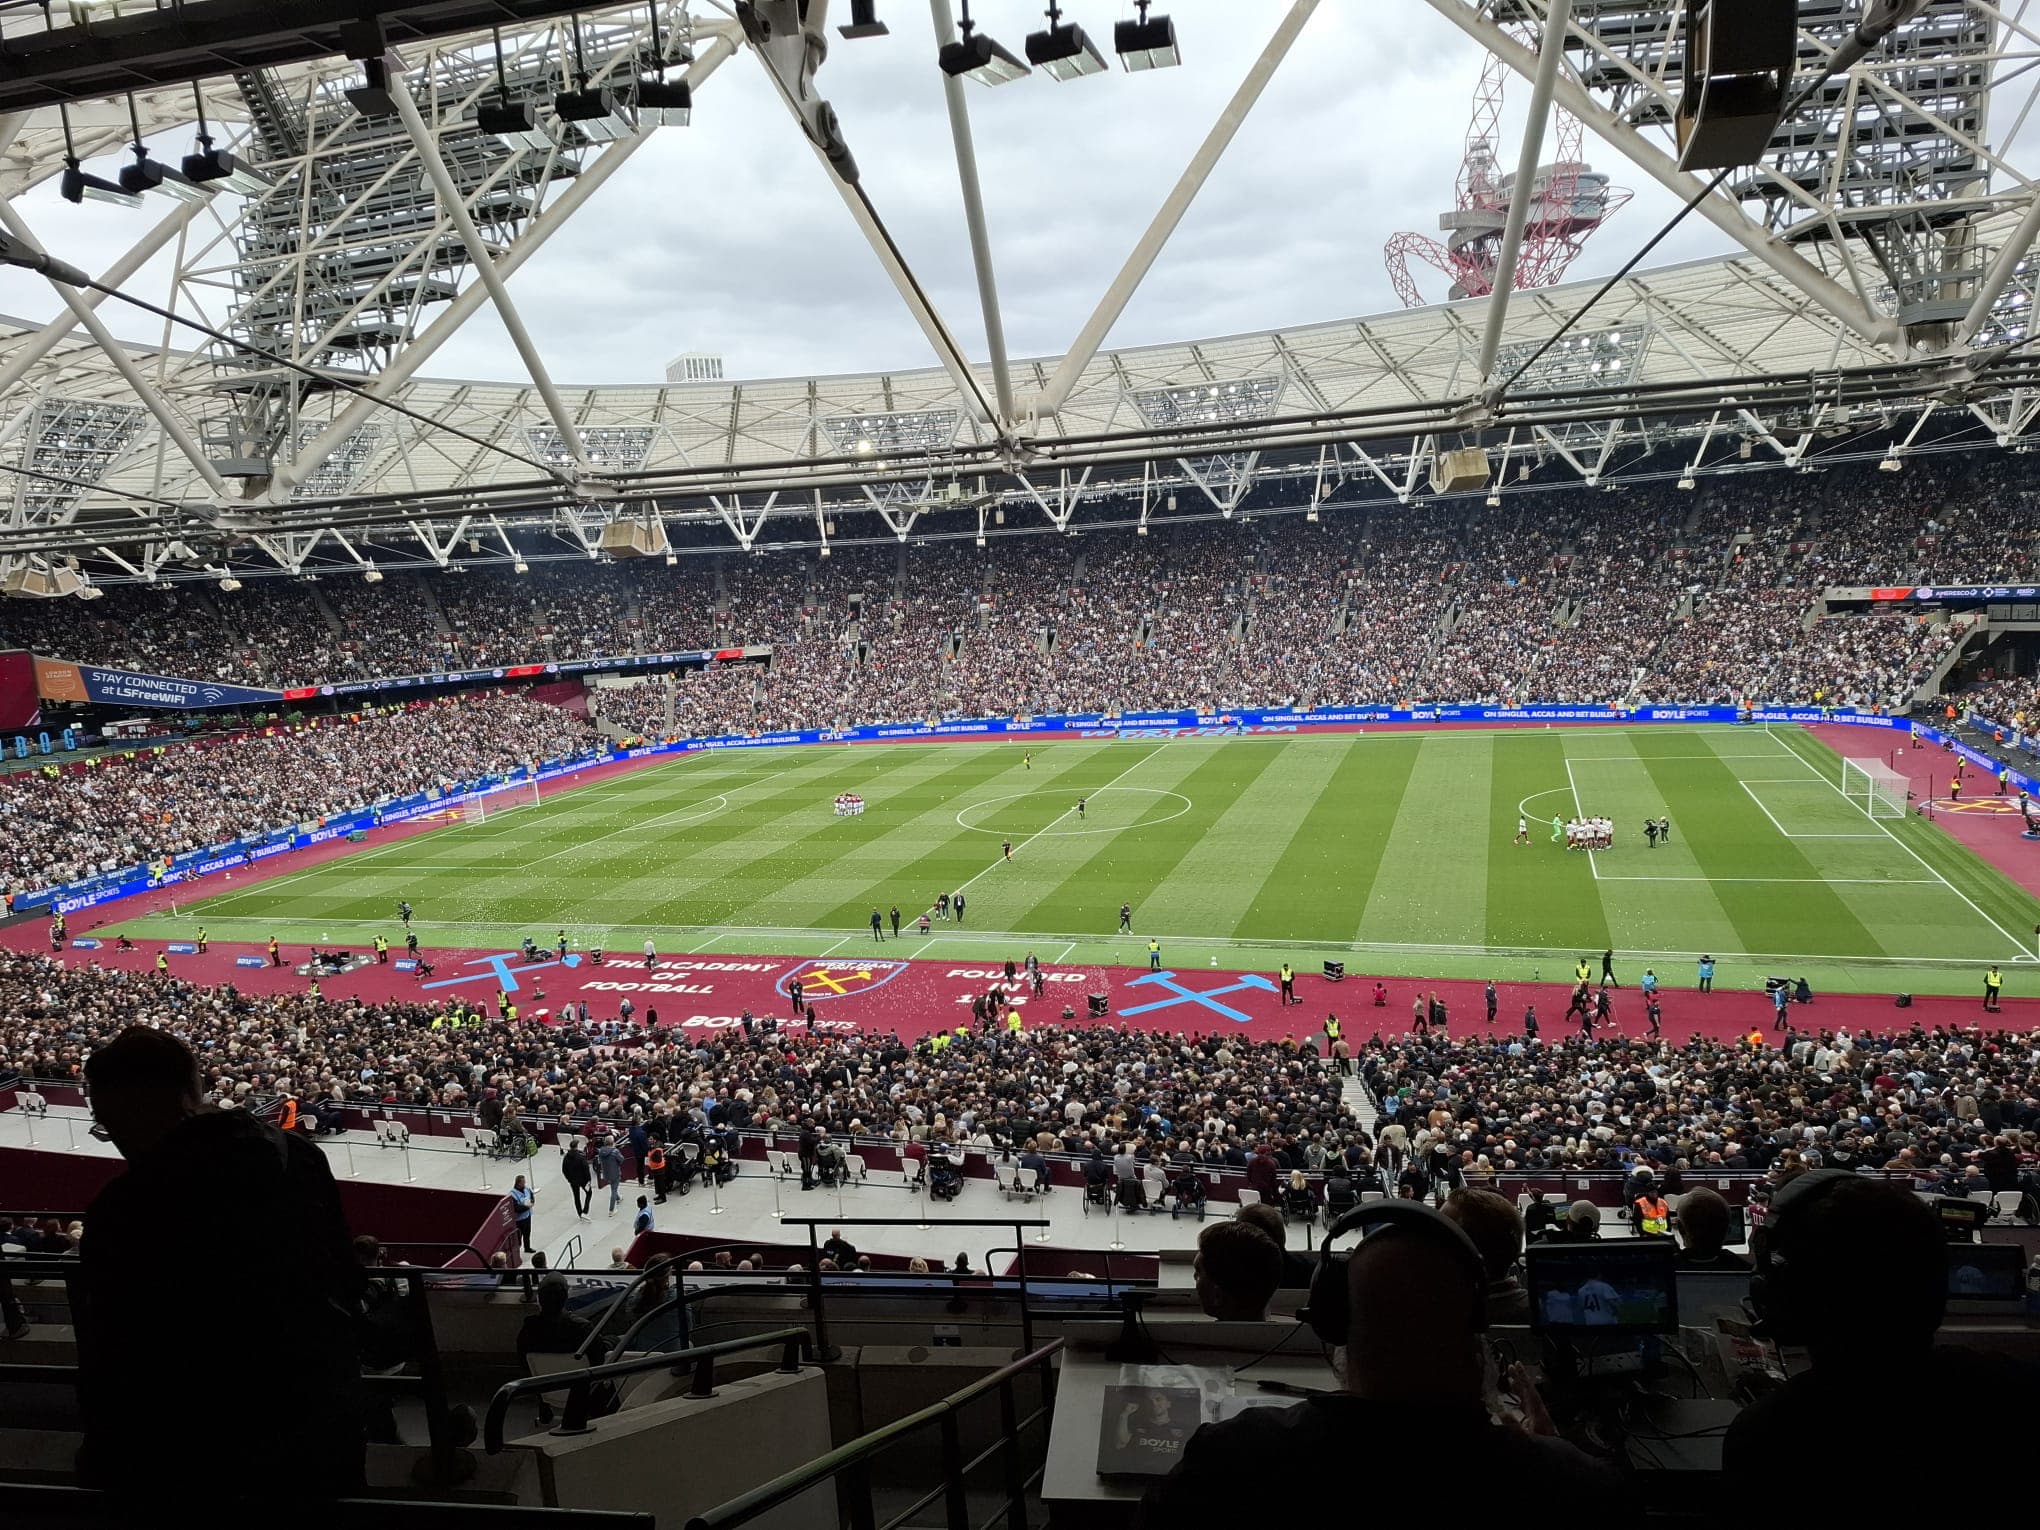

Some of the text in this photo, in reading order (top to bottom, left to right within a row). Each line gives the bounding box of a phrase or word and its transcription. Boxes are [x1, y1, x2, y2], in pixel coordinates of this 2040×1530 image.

[92, 672, 198, 695] STAY CONNECTED
[101, 686, 115, 695] at
[1412, 711, 1437, 719] BOYL
[1652, 710, 1686, 719] BOYLE
[310, 829, 338, 843] BOYLE
[199, 861, 225, 873] ACCAS
[226, 855, 243, 868] AND
[256, 842, 290, 858] BUILDERS
[58, 887, 120, 913] BOYLE SPORTS
[655, 960, 781, 972] ACADEMY
[651, 972, 692, 981] OF
[946, 969, 1087, 982] FOUNED
[579, 981, 714, 994] FOOTBALL
[988, 982, 1022, 992] IN
[955, 994, 1029, 1005] 15
[1584, 1293, 1600, 1312] 41
[1139, 1438, 1180, 1449] BOYLE
